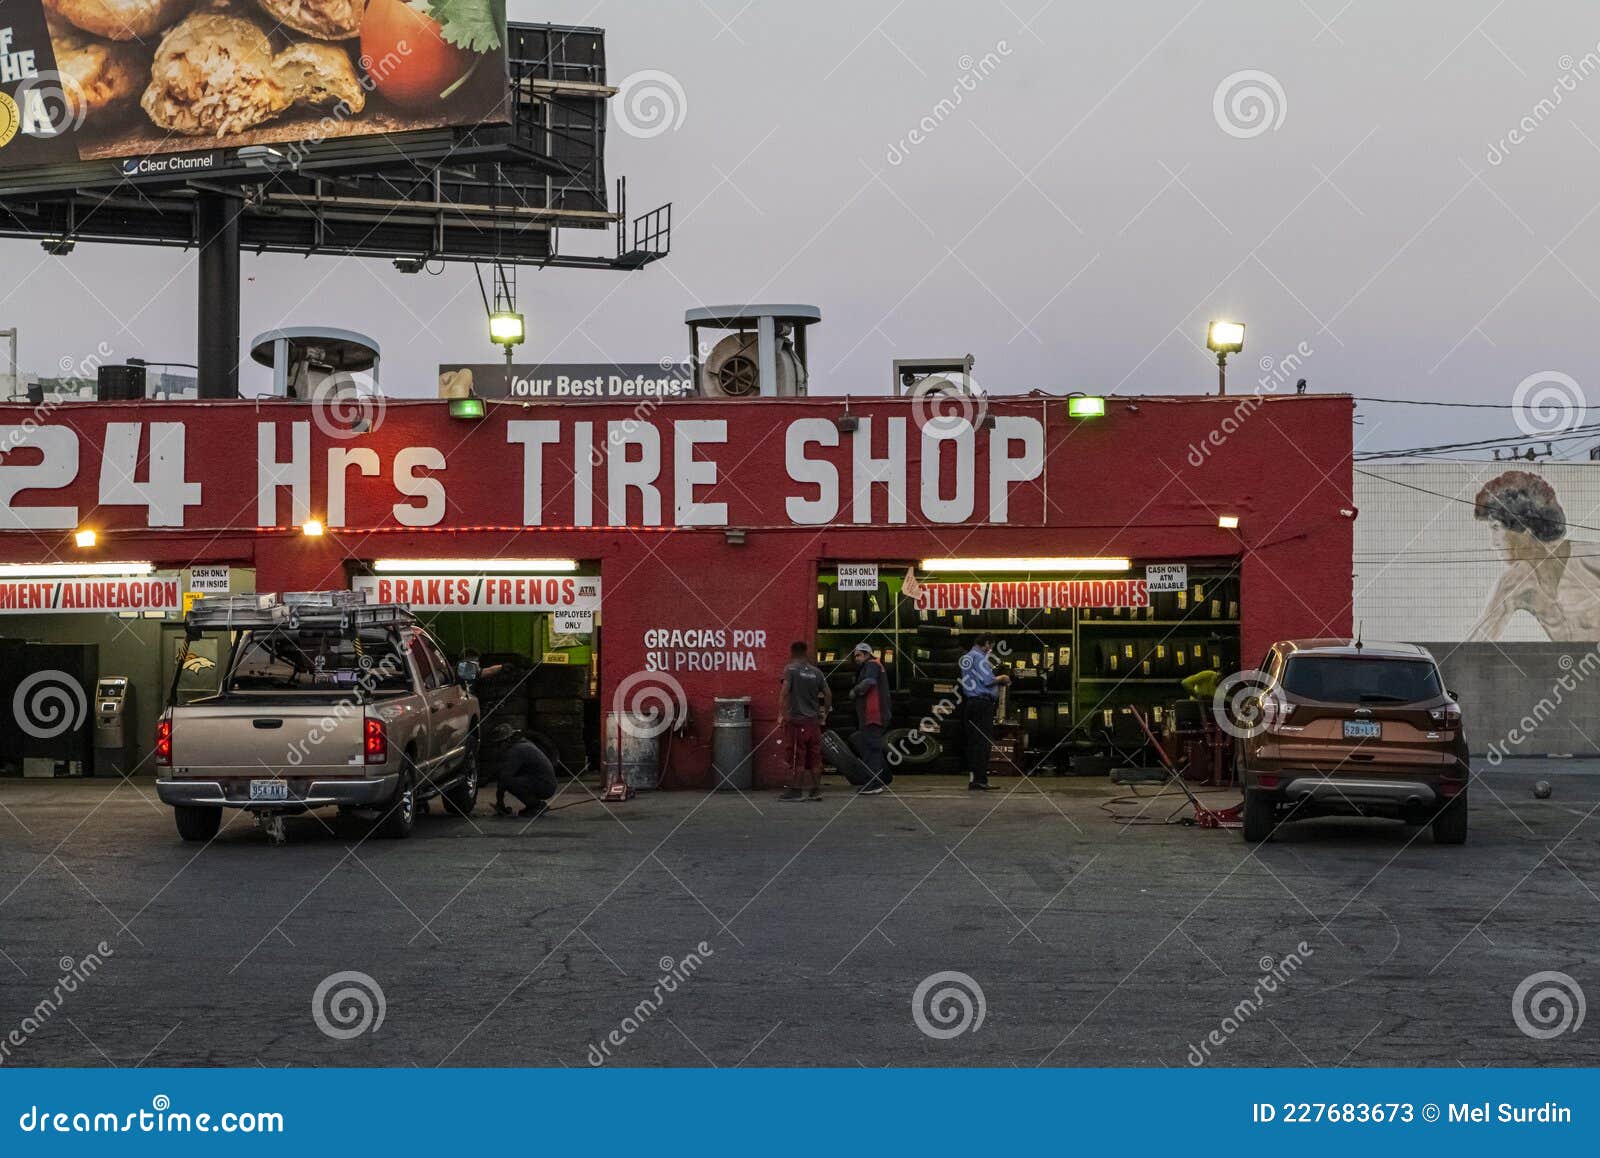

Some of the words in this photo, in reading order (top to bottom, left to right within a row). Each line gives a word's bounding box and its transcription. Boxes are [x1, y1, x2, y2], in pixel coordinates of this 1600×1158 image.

[139, 159, 168, 172] Clear
[169, 154, 213, 169] Channel
[557, 376, 603, 397] Best
[0, 421, 202, 528] 24
[257, 421, 447, 528] Hrs
[506, 418, 729, 527] TIRE
[785, 416, 1045, 525] SHOP
[191, 569, 209, 578] CASH
[210, 569, 228, 578] ONLY
[839, 567, 858, 576] CASH
[858, 567, 876, 576] ONLY
[1147, 566, 1166, 574] CASH
[1167, 566, 1185, 574] ONLY
[1159, 574, 1174, 582] ATM
[191, 580, 205, 588] ATM
[206, 580, 228, 588] INSIDE
[839, 578, 853, 587] ATM
[854, 578, 877, 588] INSIDE
[1149, 582, 1184, 590] AVAILABLE
[378, 578, 576, 606] BRAKES/FRENOS
[579, 585, 596, 593] ATM
[554, 610, 592, 619] EMPLOYEES
[564, 621, 581, 630] ONLY
[644, 629, 726, 649] GRACIAS
[733, 630, 767, 648] POR
[645, 651, 669, 672] SU
[675, 651, 758, 671] PROPINA
